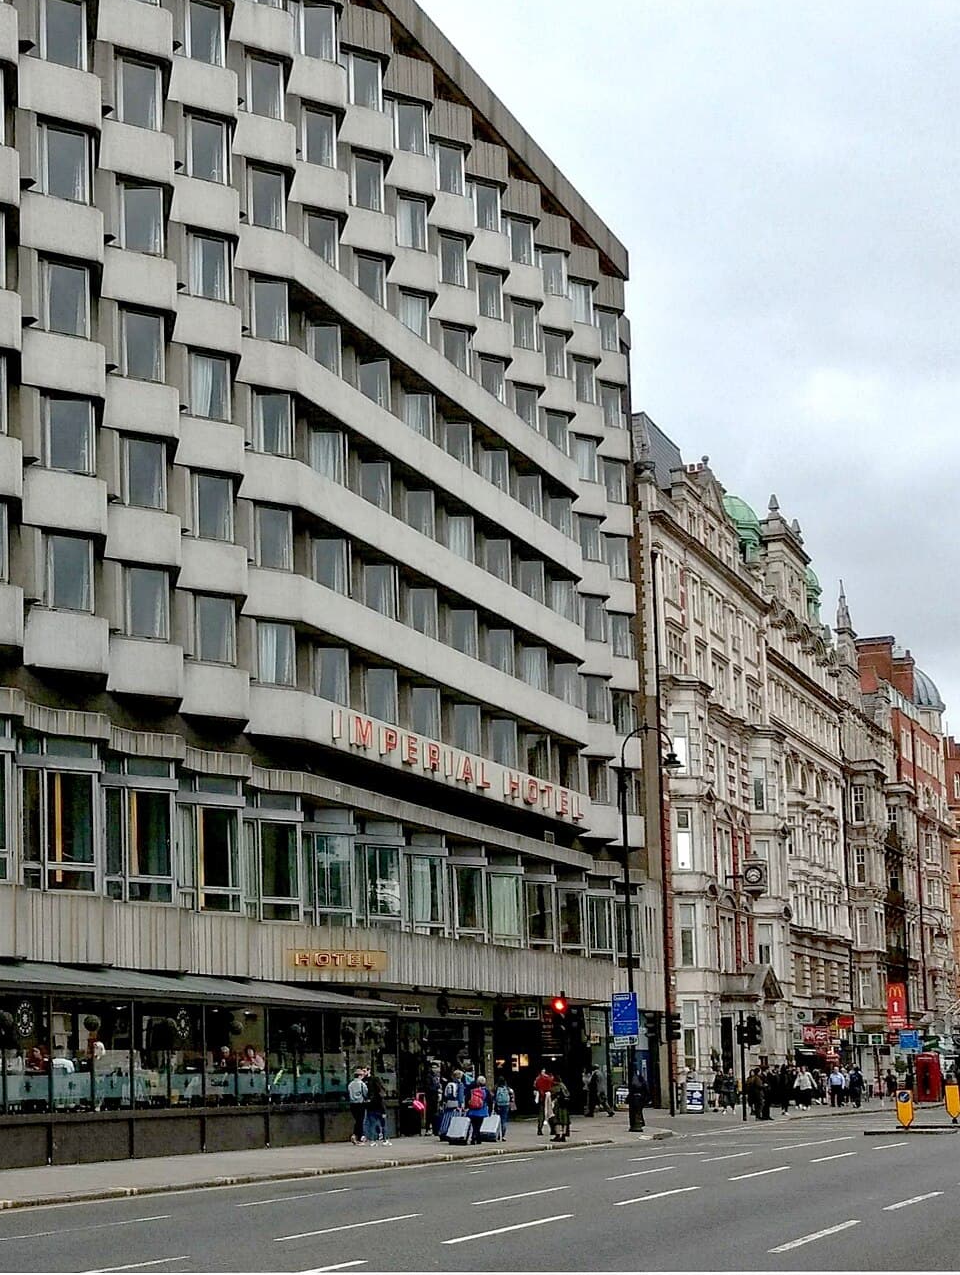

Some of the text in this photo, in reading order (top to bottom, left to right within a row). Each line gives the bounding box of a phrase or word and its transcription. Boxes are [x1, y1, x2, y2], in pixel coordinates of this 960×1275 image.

[331, 709, 585, 823] IMPERIAL HOTEL
[294, 952, 377, 967] HOTEL
[528, 1007, 536, 1017] P
